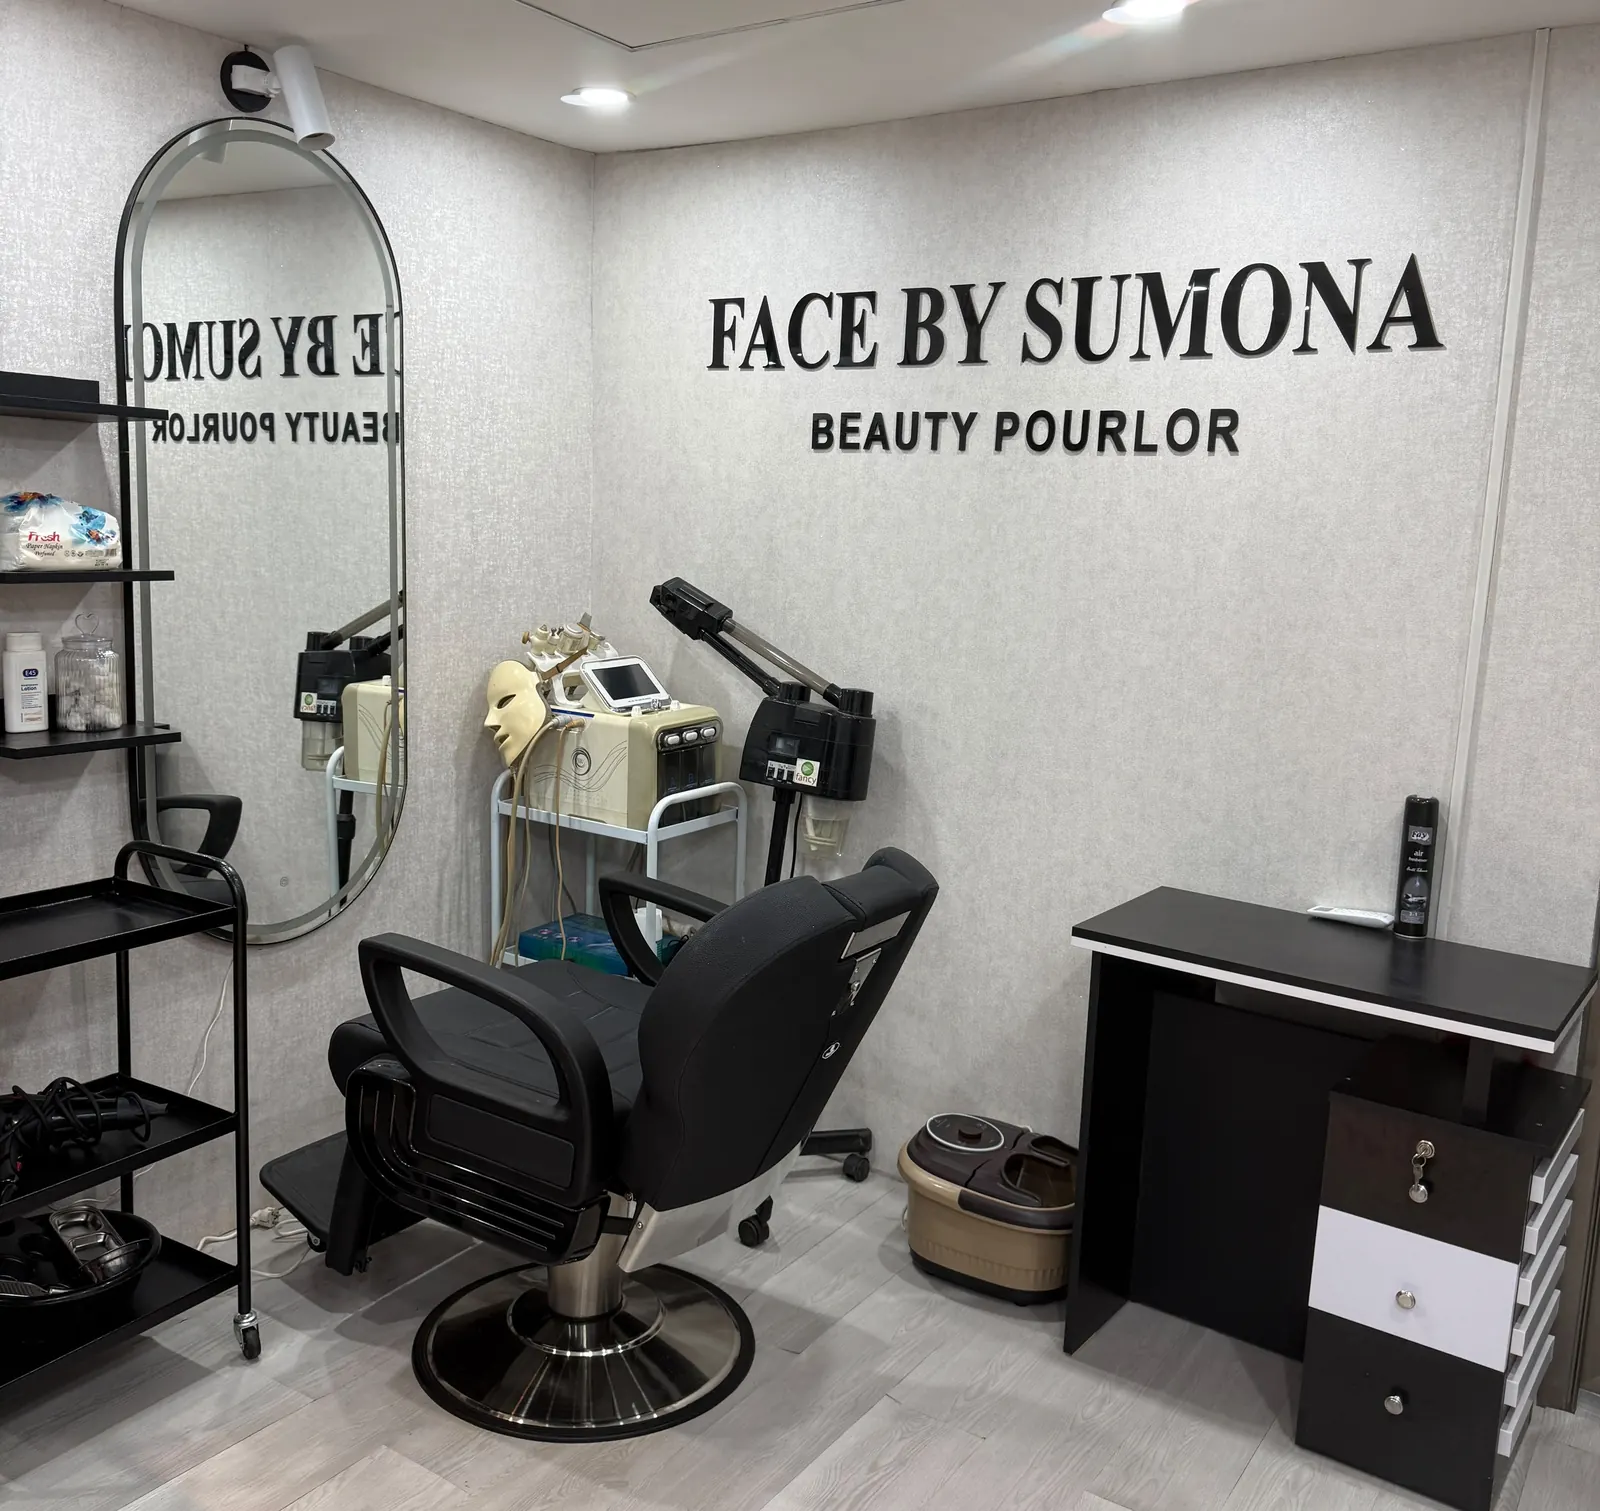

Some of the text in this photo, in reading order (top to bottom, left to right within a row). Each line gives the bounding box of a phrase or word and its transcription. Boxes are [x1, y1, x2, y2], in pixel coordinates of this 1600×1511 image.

[707, 253, 1446, 370] FACE BY SUMONA
[811, 408, 1239, 454] BEAUTY POURLOR
[28, 531, 60, 542] Fresh
[24, 669, 37, 677] E45
[795, 772, 817, 785] fancy
